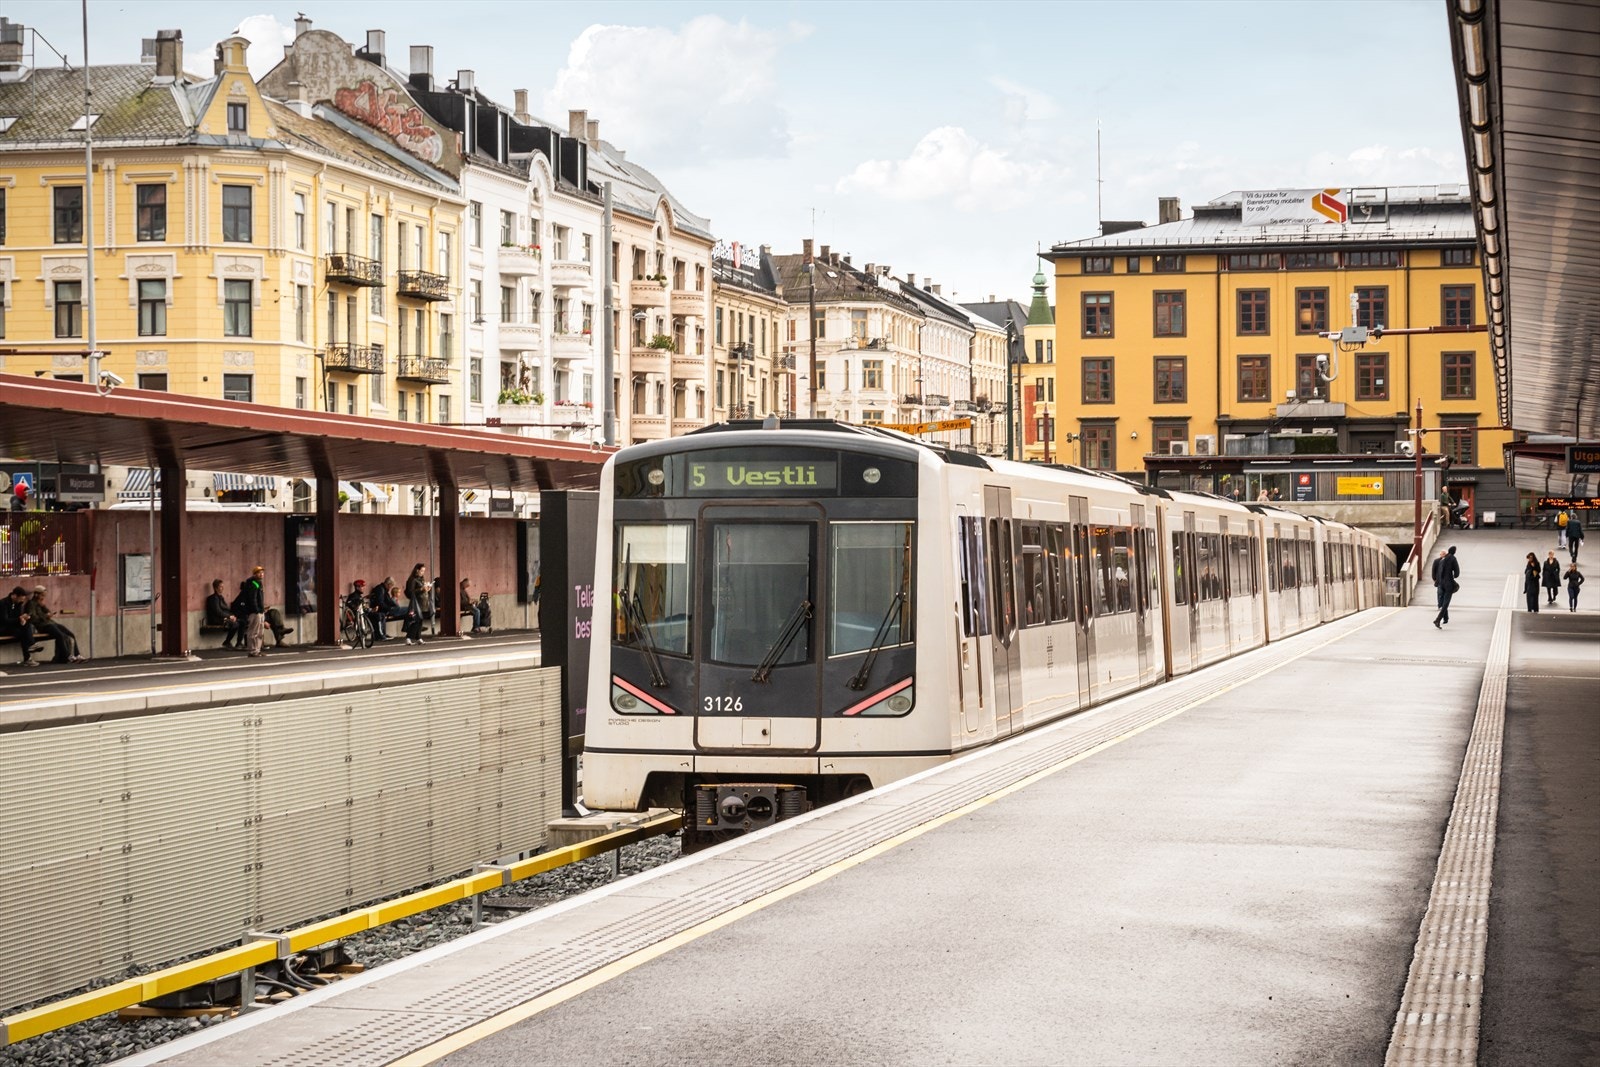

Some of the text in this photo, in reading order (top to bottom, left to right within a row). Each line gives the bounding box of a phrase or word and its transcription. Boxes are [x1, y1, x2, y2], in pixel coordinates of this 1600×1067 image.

[1262, 192, 1278, 200] jobbe
[942, 421, 967, 430] Skøyen
[693, 466, 818, 487] 5 Vestli
[704, 696, 743, 712] 3126
